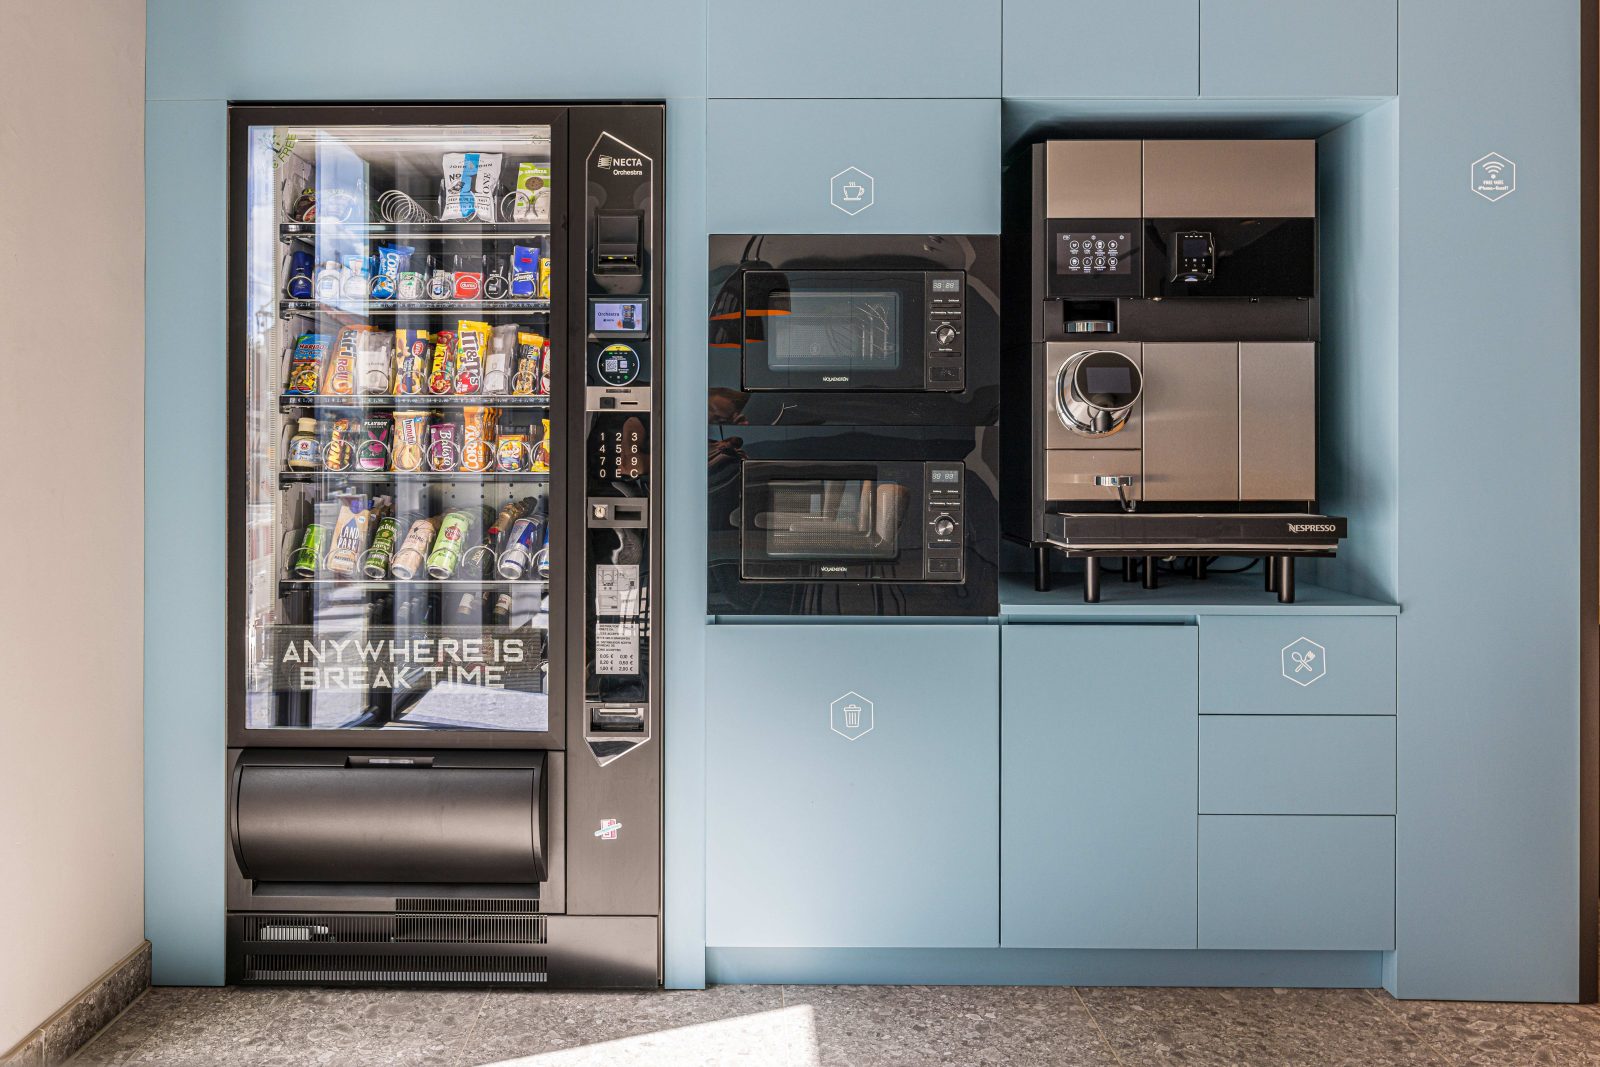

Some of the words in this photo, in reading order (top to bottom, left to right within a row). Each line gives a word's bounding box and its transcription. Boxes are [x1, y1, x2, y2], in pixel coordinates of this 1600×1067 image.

[612, 158, 643, 167] NECTA
[482, 172, 492, 194] ONE
[404, 419, 416, 445] hanuta
[600, 432, 605, 441] 1
[616, 432, 622, 441] 2
[632, 432, 638, 441] 3
[439, 430, 453, 466] Balisto
[464, 425, 479, 470] CORNY
[600, 444, 605, 453] 4
[616, 444, 622, 453] 5
[632, 444, 638, 453] 6
[600, 456, 605, 466] 7
[616, 456, 622, 466] 8
[632, 456, 638, 466] 9
[600, 469, 606, 478] 0
[616, 469, 621, 478] E
[630, 469, 638, 478] C
[340, 526, 360, 540] LAND
[1287, 523, 1337, 533] NESPRESSO
[282, 639, 484, 663] ANYWHERE
[493, 639, 524, 663] IS
[300, 666, 412, 690] BREAK
[423, 666, 505, 690] TIME
